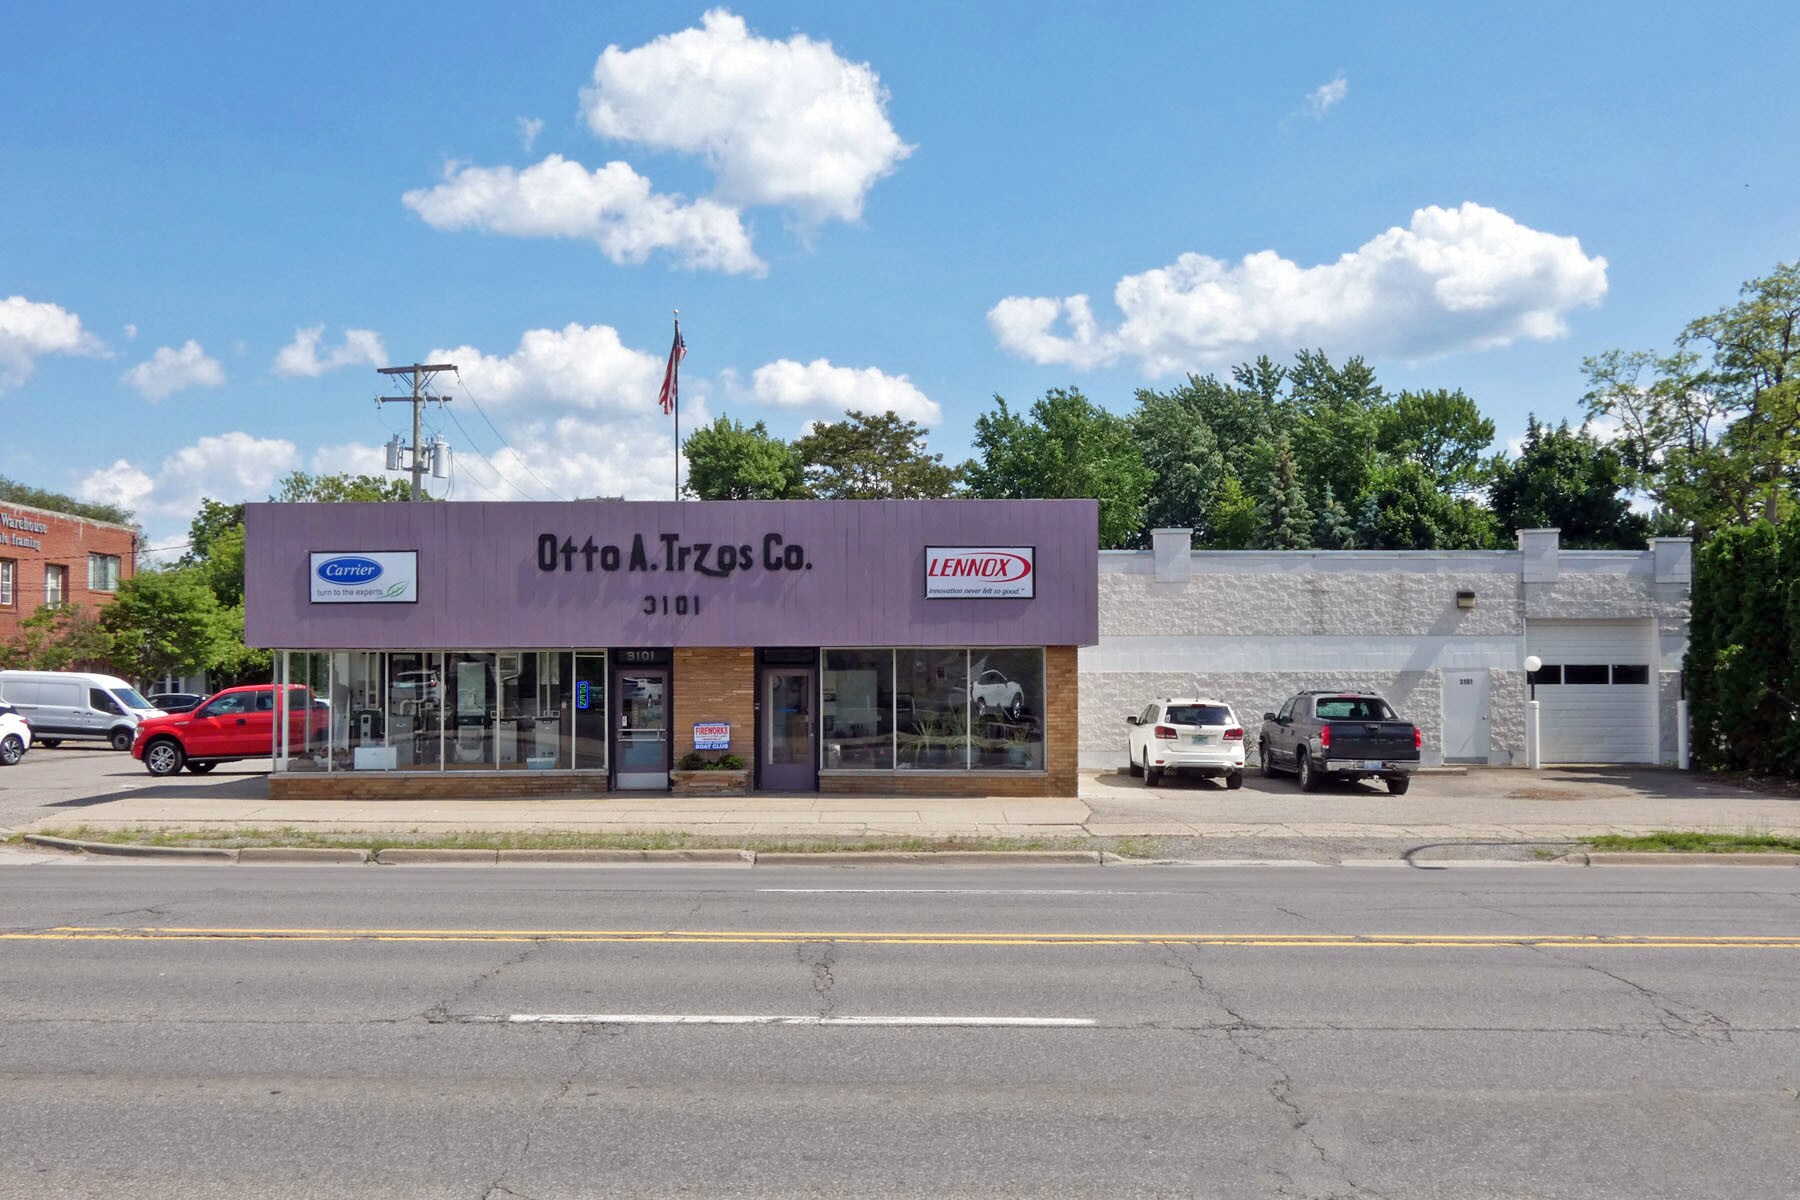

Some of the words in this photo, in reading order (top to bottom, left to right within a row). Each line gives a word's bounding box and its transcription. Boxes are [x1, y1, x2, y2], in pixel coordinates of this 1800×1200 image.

[0, 513, 48, 534] Warehouse
[537, 533, 620, 572] Otto
[763, 533, 813, 572] Co.
[326, 564, 375, 576] Carrier
[928, 558, 1011, 577] LENNOX
[355, 588, 383, 597] experts
[982, 587, 993, 595] felt
[643, 595, 700, 615] 3101
[626, 650, 655, 661] 3101
[695, 727, 728, 736] FIREWORKS
